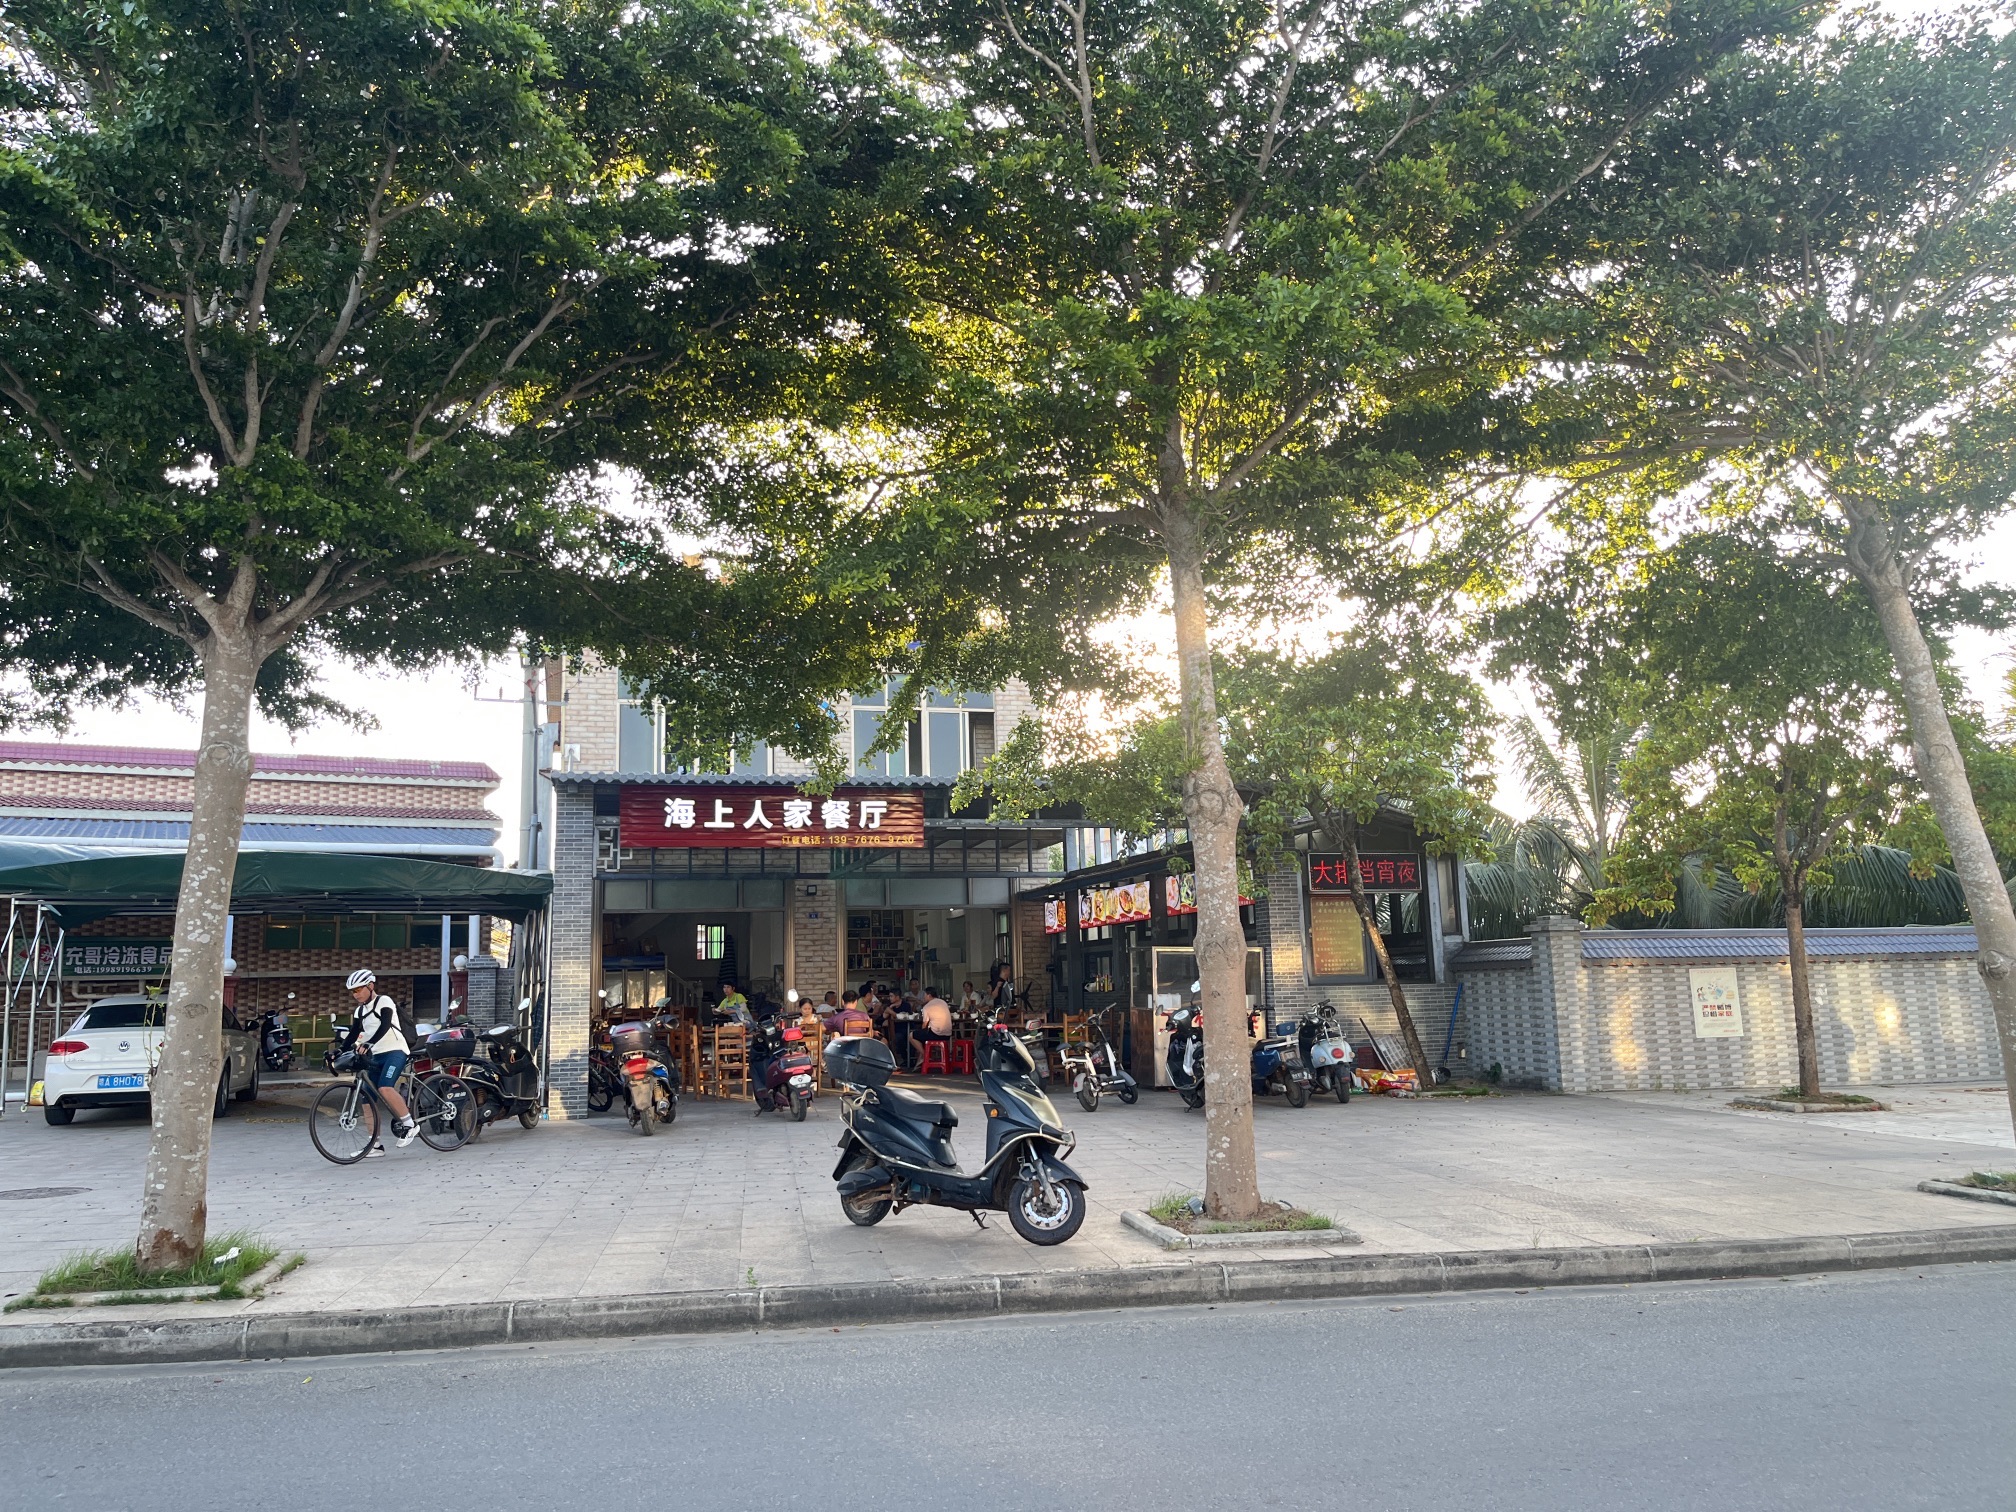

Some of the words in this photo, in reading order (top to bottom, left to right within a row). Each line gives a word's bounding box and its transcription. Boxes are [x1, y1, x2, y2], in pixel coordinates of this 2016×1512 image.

[664, 798, 888, 829] 海上人家餐厅
